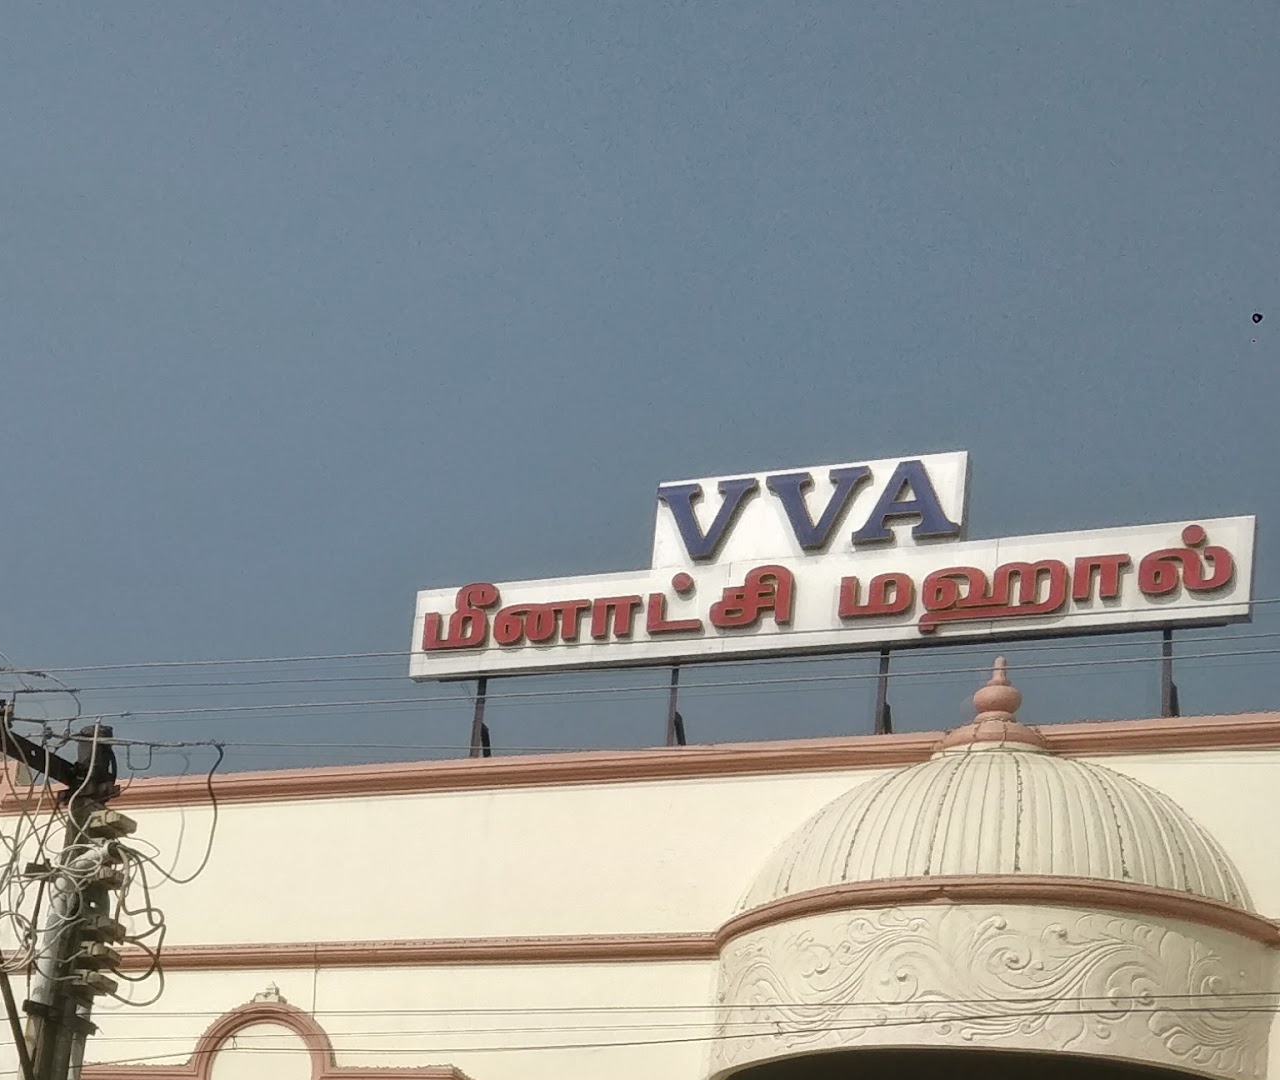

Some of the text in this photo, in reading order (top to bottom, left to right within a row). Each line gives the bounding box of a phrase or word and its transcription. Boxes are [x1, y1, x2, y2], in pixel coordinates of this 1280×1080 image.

[656, 459, 962, 560] VVA
[423, 523, 1233, 652] மீனாட்சி மஹால்
